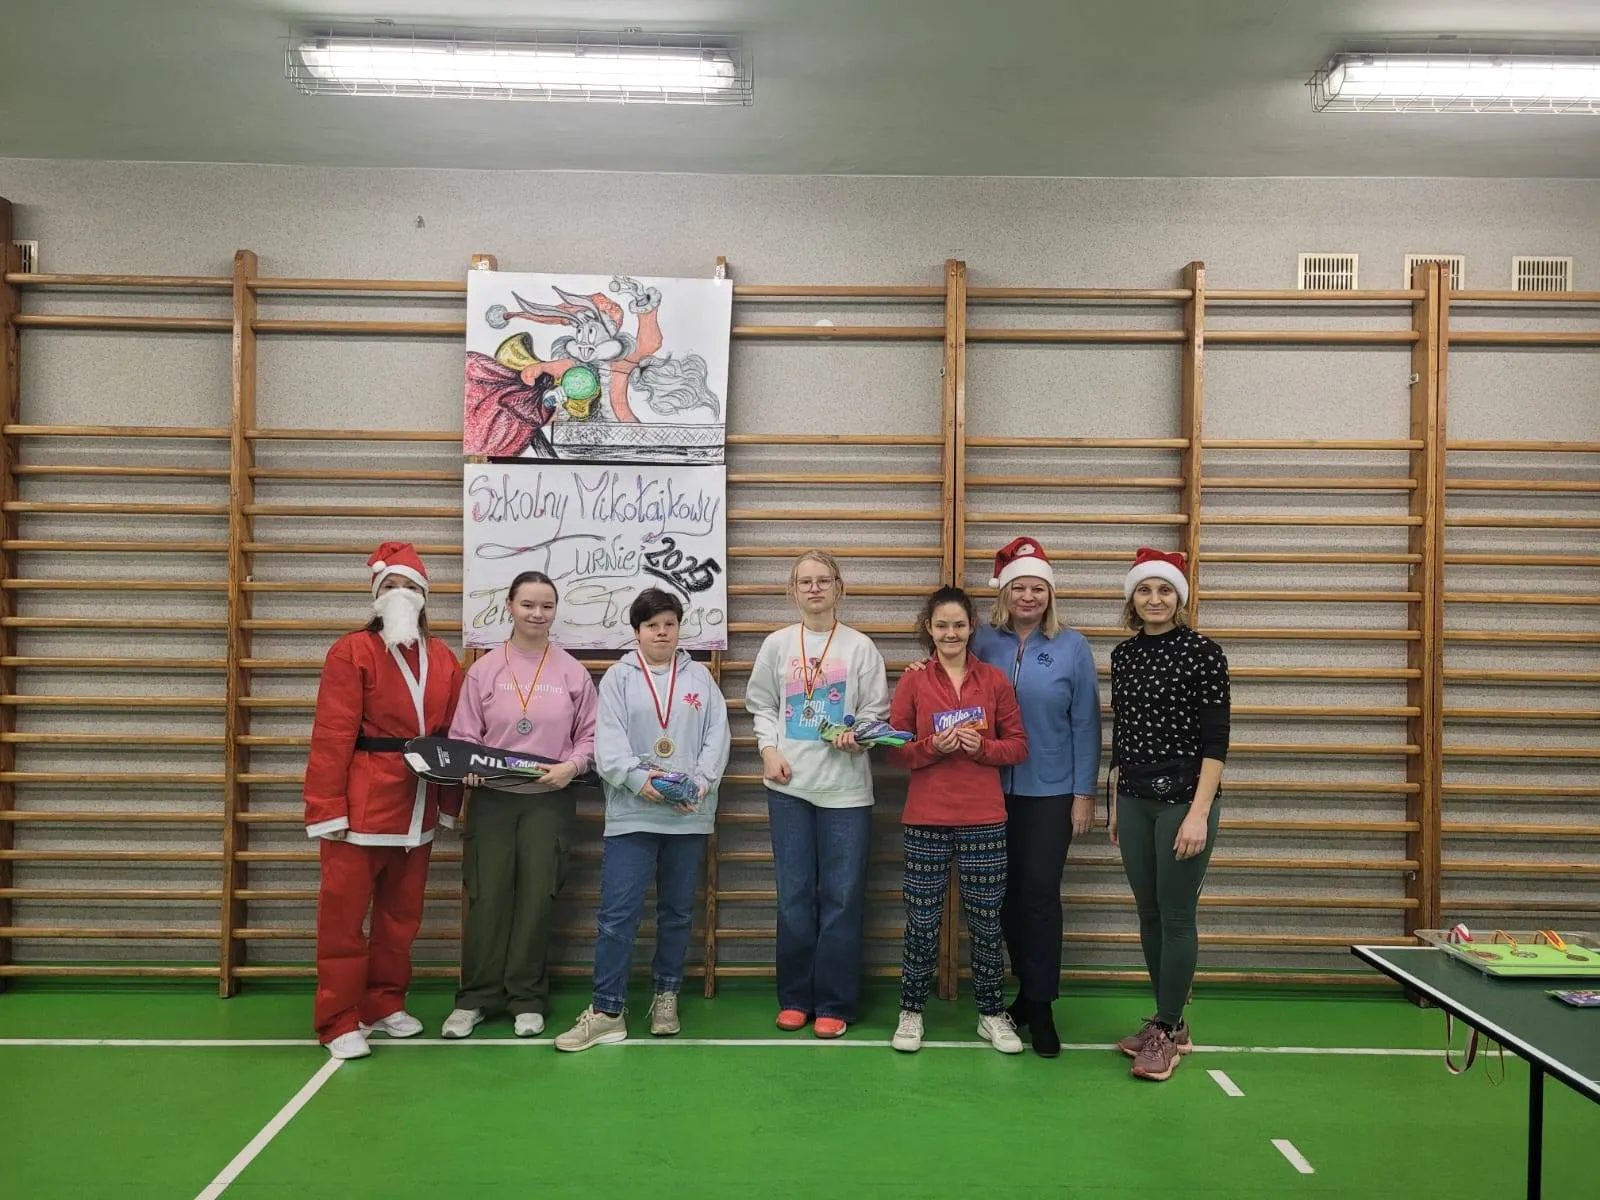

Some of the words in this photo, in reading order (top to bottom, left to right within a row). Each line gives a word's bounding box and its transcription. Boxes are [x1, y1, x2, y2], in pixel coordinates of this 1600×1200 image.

[468, 471, 568, 540] Szkolny
[572, 470, 720, 543] Mikołajkowy
[644, 537, 722, 592] 2025
[939, 709, 970, 730] Milka
[469, 754, 509, 769] NIL
